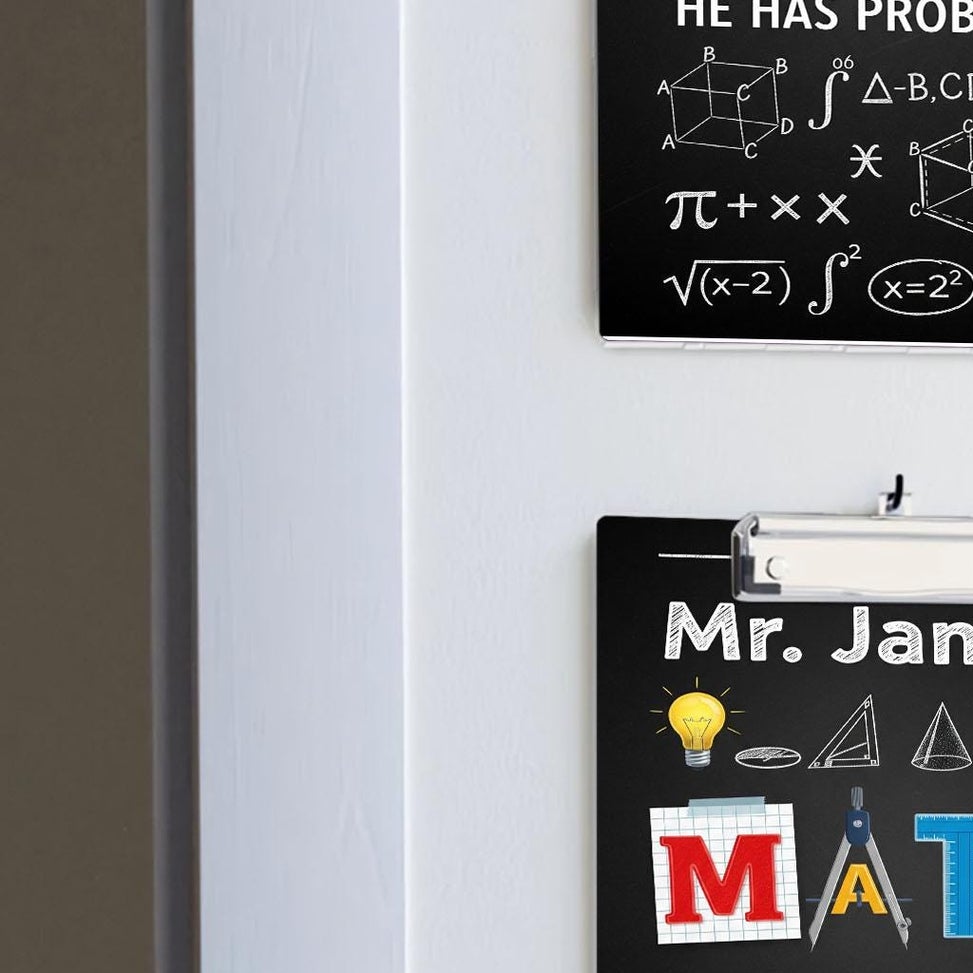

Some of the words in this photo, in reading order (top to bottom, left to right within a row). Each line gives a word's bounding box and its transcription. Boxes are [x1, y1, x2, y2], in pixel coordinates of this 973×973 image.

[678, 0, 733, 28] HE
[752, 0, 839, 31] HAS
[664, 601, 804, 664] Mr.
